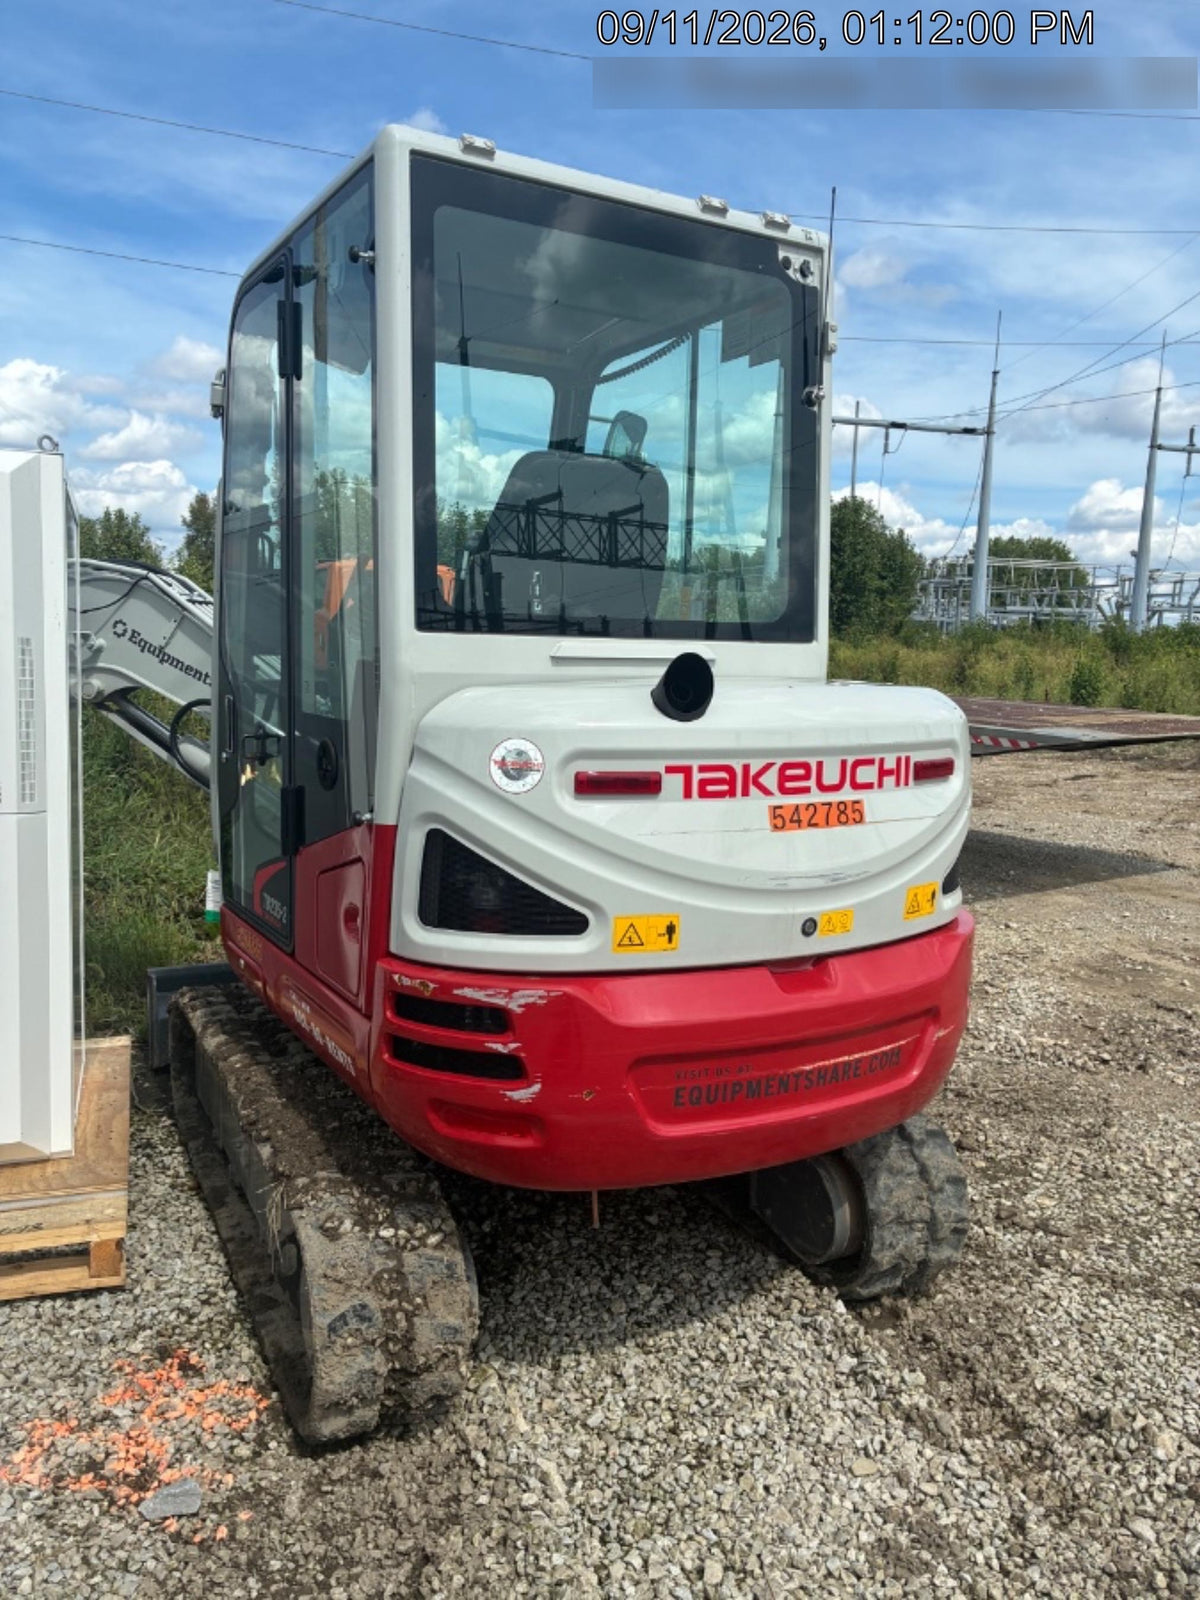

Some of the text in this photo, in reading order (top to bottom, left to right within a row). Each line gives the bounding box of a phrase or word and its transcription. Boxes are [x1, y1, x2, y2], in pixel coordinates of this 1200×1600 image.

[664, 756, 911, 799] TAKEUCHI
[772, 801, 864, 830] 542785
[673, 1048, 901, 1108] EQUIPMENTSHARE.COM
[675, 1067, 711, 1080] VISIT
[715, 1065, 731, 1077] US
